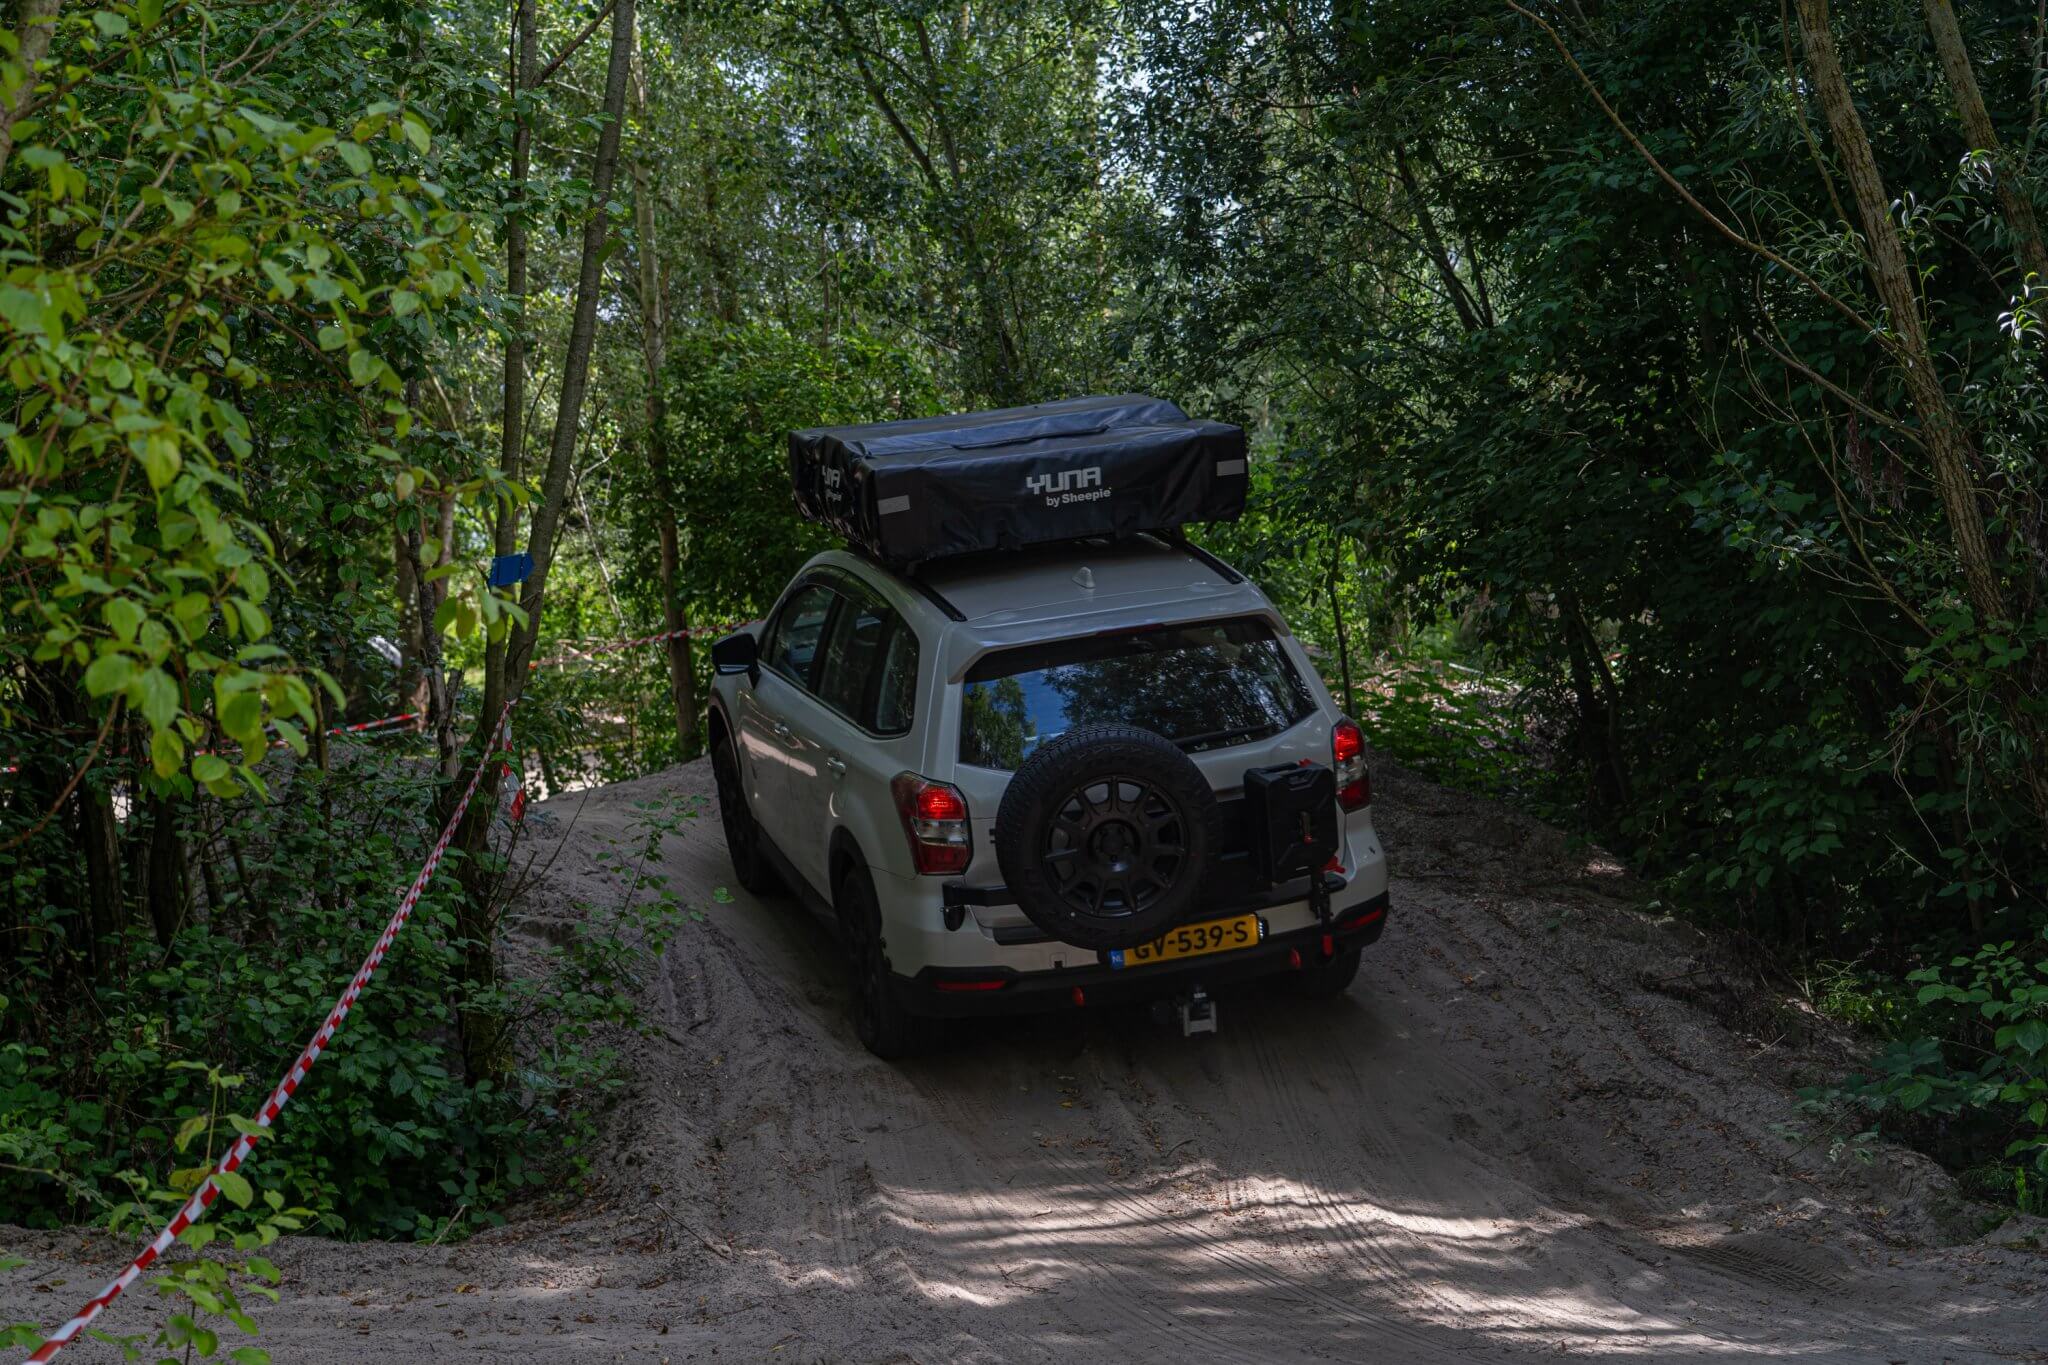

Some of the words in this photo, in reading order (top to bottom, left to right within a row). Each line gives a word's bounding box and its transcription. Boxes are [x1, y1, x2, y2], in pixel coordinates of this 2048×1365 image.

[1026, 466, 1102, 495] YUNA
[1046, 495, 1060, 508] by
[1062, 488, 1112, 504] Sheepie
[1134, 921, 1248, 960] GV-539-S
[1112, 955, 1124, 963] NL
